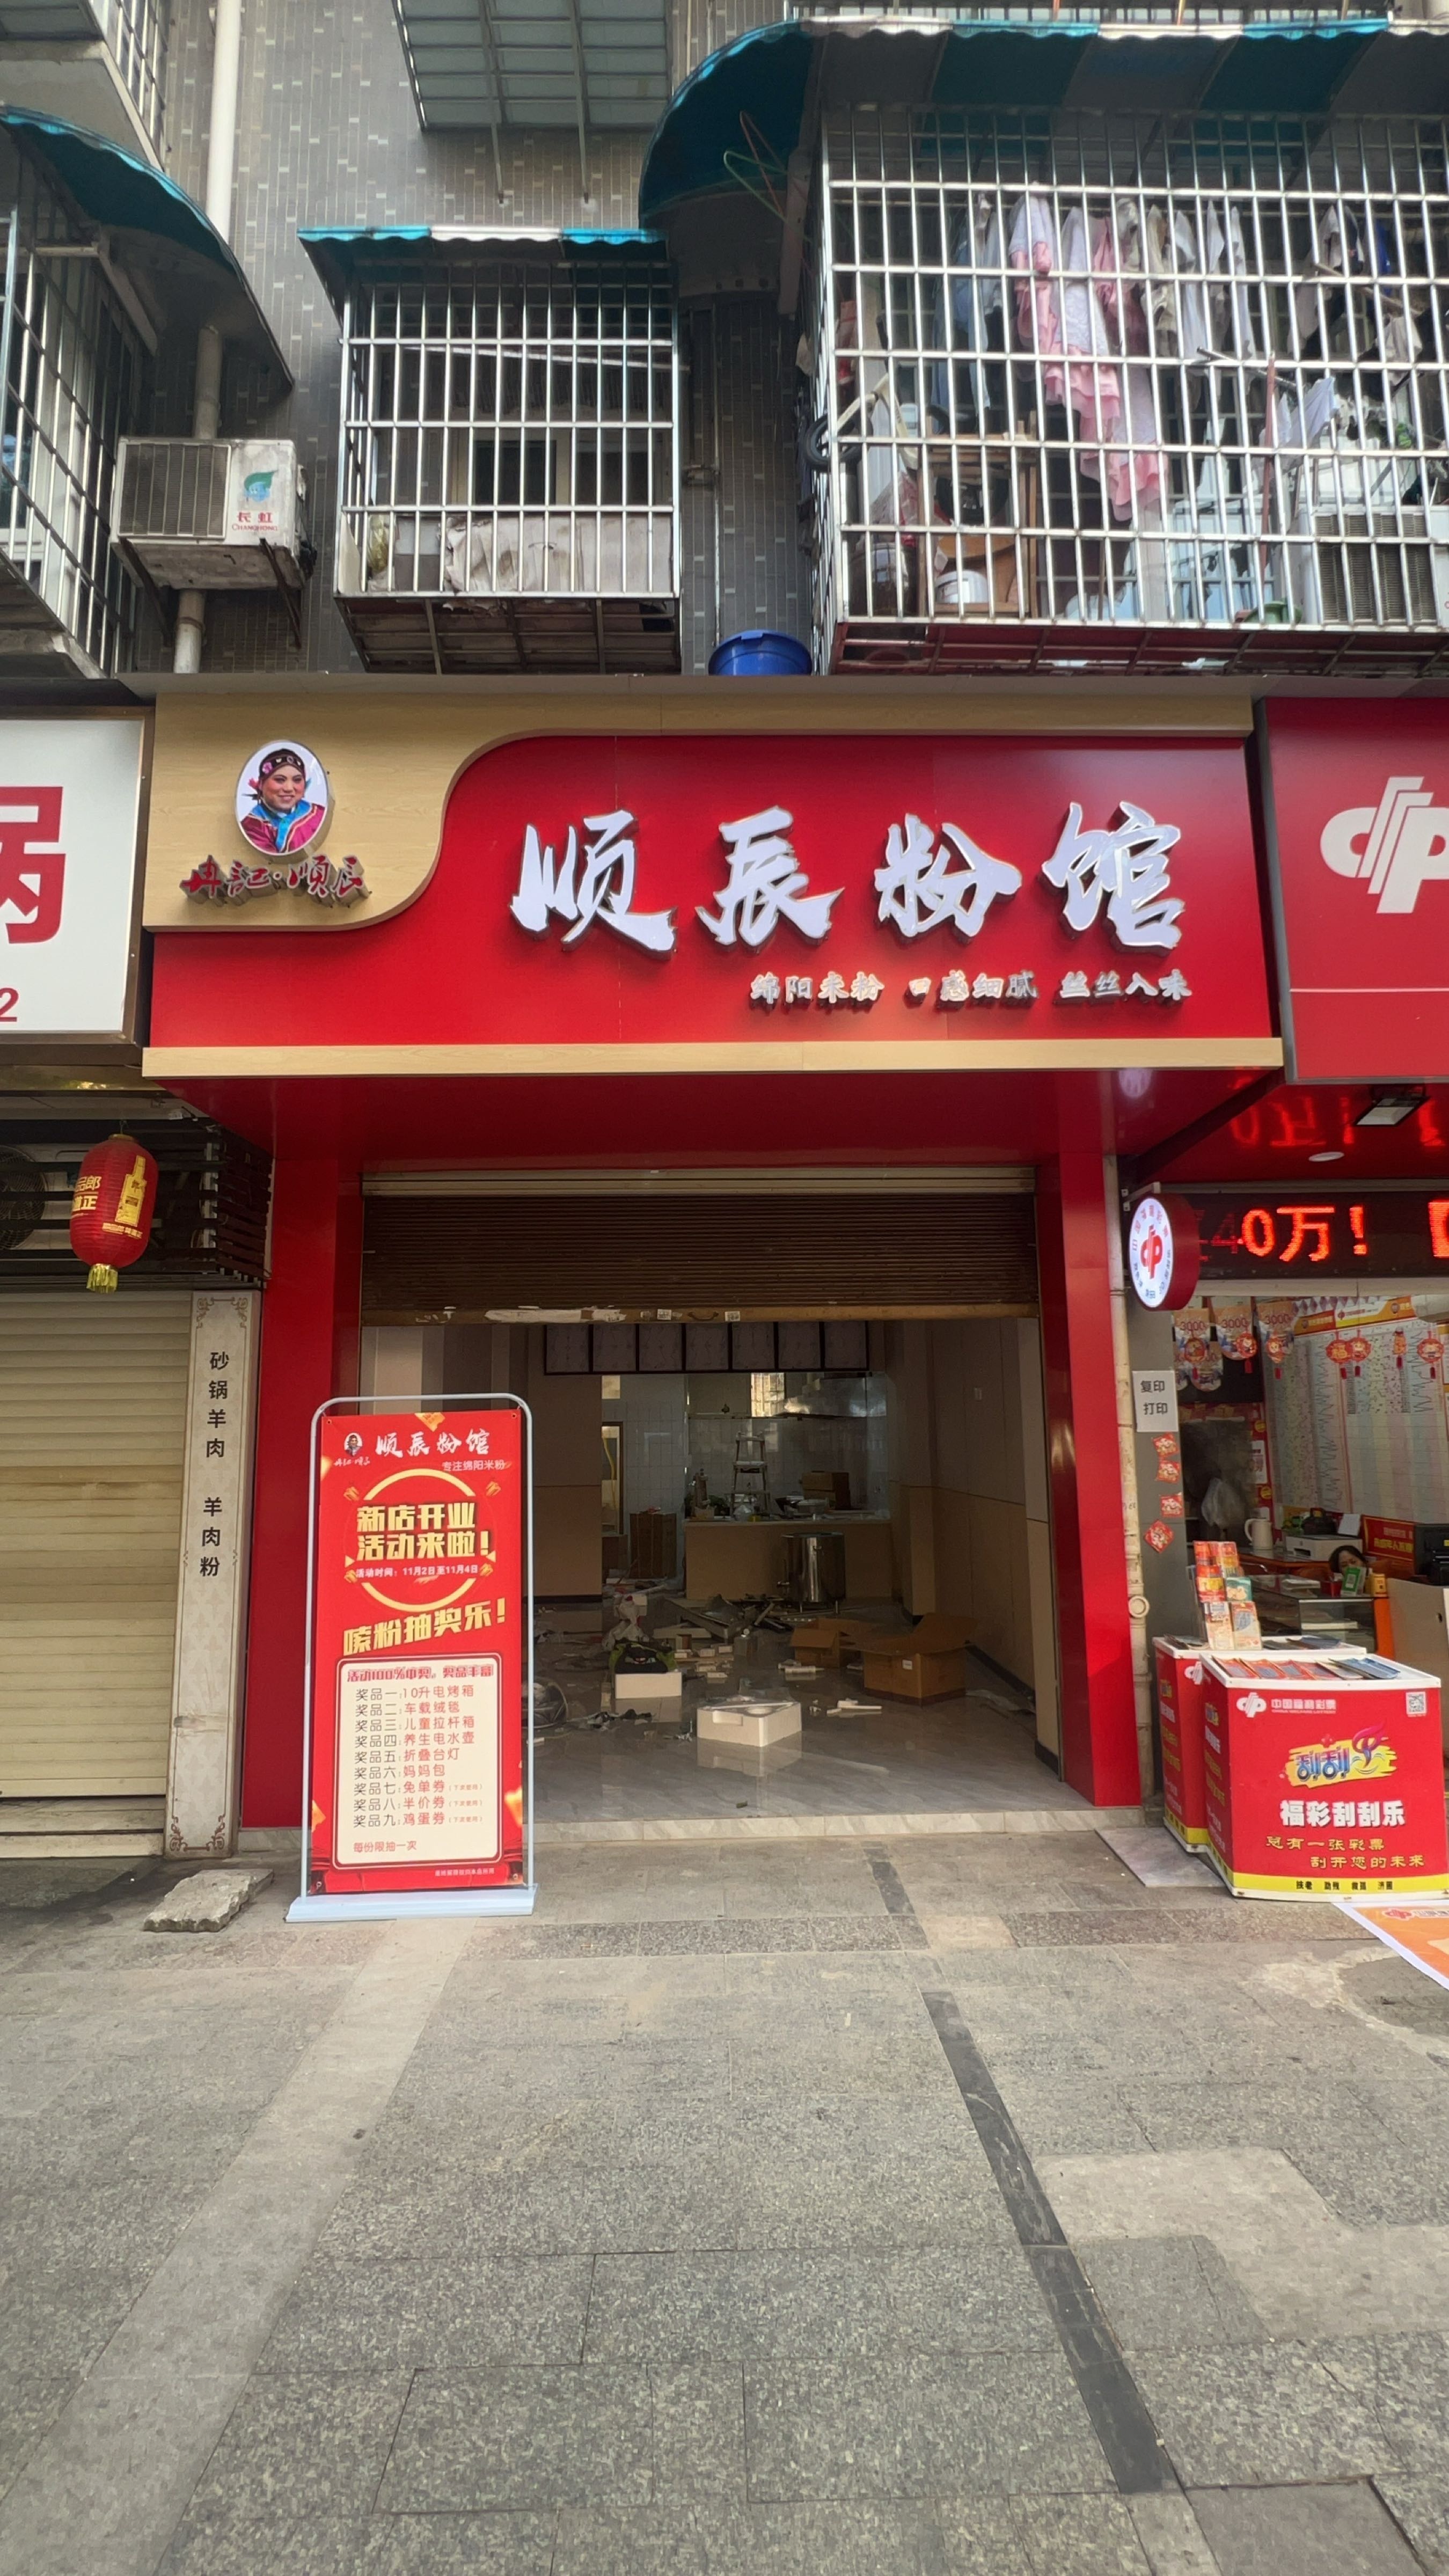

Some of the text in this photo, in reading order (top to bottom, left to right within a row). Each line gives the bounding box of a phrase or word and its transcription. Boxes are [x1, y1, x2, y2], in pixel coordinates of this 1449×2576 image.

[237, 511, 273, 523] 长虹
[509, 801, 1185, 953] 顺辰粉馆
[749, 968, 1192, 1006] 绵阳米粉 口感细腻 丝丝入味
[1140, 1380, 1165, 1393] 复印
[1143, 1402, 1168, 1415] 打印
[375, 1428, 491, 1458] 顺辰粉馆
[200, 1351, 230, 1577] 砂锅羊肉 羊肉粉
[442, 1460, 506, 1472] 专注绵阳米粉
[356, 1502, 476, 1532] 新店开业
[356, 1530, 489, 1561] 活动来啦！
[343, 1597, 506, 1657] 嗦粉抽奖乐！
[1280, 1799, 1406, 1828] 福彩刮刮乐
[353, 1840, 417, 1853] 每份限抽一次
[1266, 1835, 1385, 1851] 总有一张彩票
[1310, 1855, 1425, 1870] 刮开您的未来
